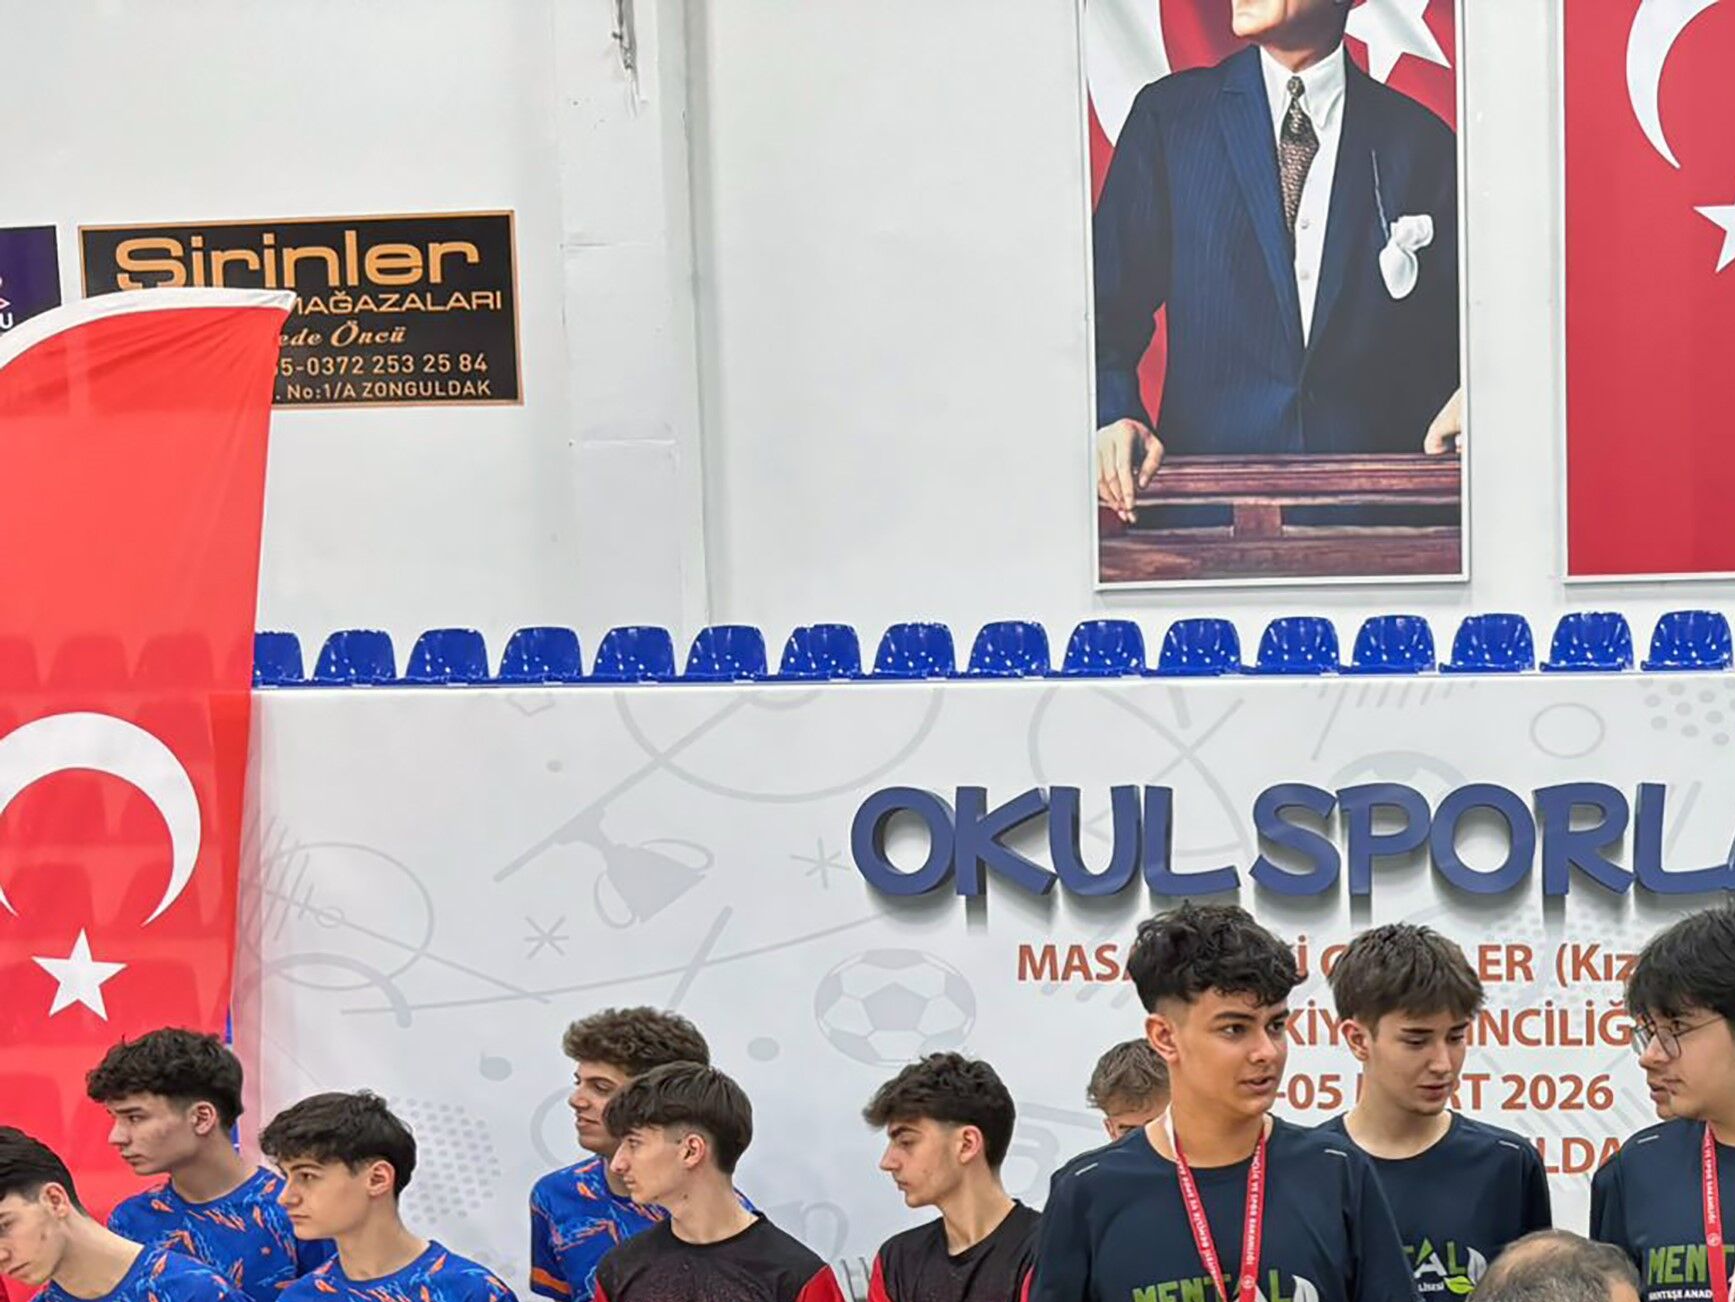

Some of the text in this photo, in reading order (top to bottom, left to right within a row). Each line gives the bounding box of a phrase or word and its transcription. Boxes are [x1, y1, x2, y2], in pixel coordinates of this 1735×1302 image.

[330, 320, 406, 347] Öncü
[275, 352, 489, 376] 5-0372 253 25 84
[287, 380, 492, 400] No:1/A ZONGULDAK
[850, 781, 1239, 897] OKUL
[1017, 944, 1130, 982] MAS
[1501, 1074, 1615, 1111] 2026
